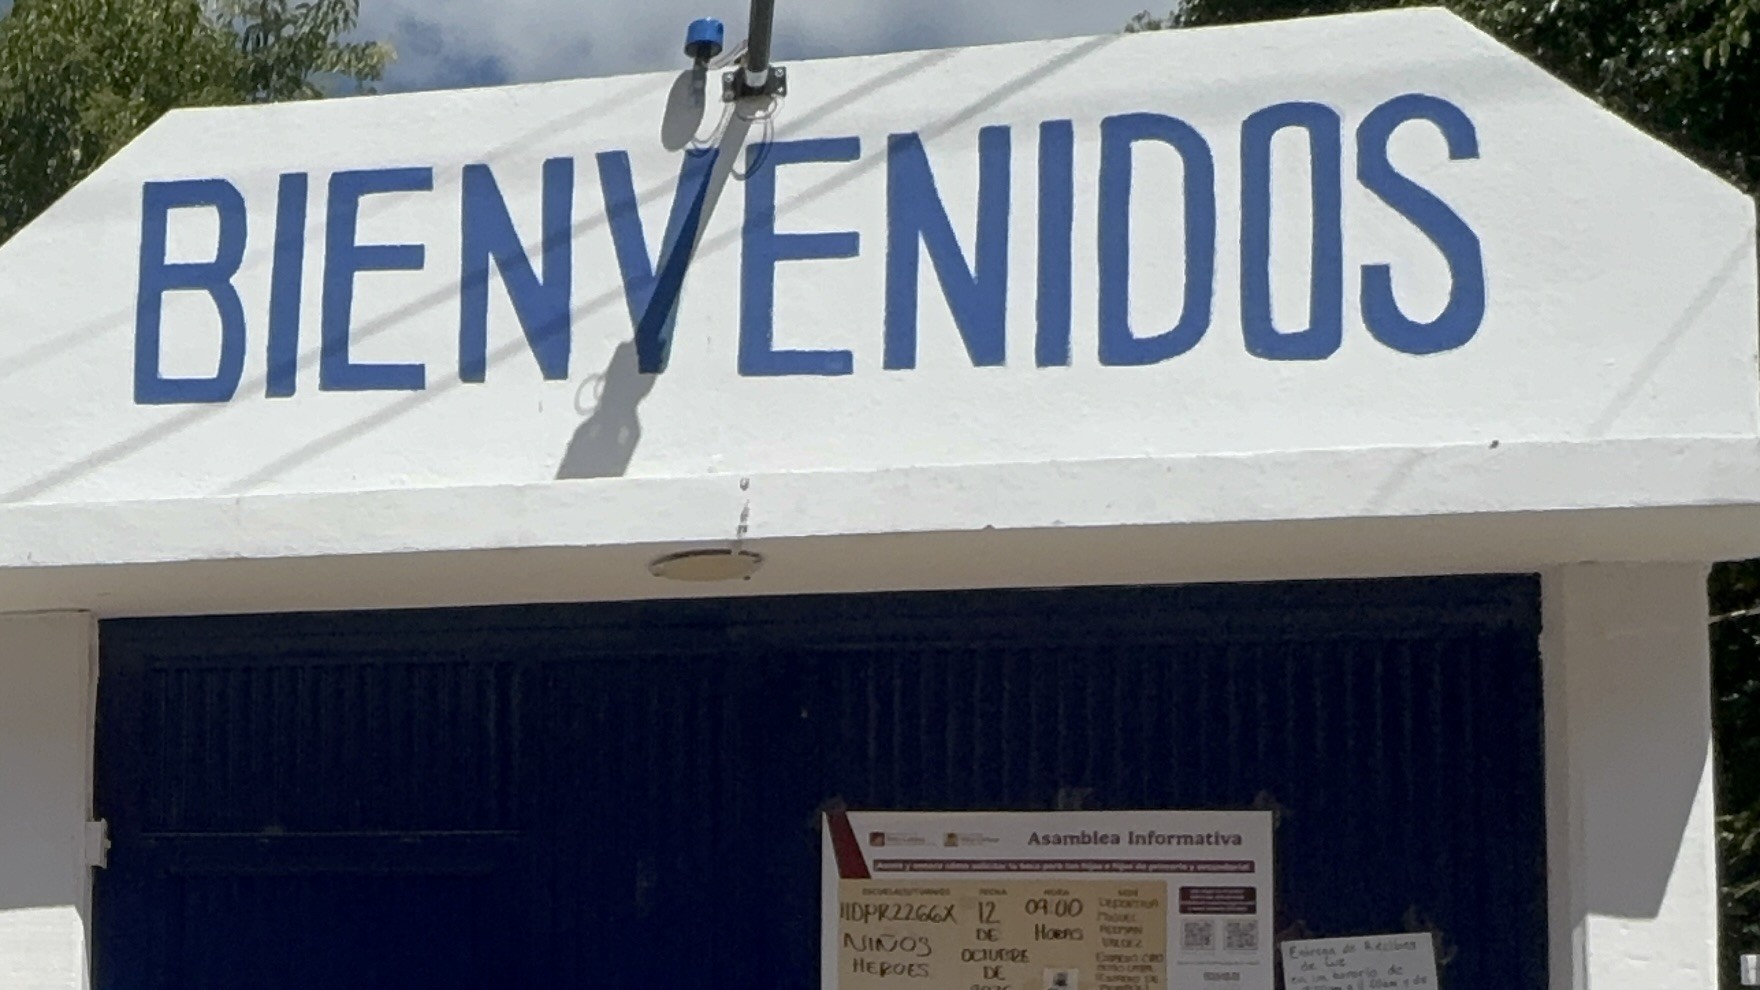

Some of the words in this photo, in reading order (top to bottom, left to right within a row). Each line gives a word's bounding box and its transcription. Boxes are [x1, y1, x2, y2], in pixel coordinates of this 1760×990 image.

[134, 93, 1486, 405] BIENVENIDOS
[1028, 830, 1120, 846] Asamblea
[1128, 830, 1243, 847] Informativa
[978, 901, 1001, 924] 12
[843, 932, 932, 958] NIÑOS
[976, 928, 999, 943] DE
[853, 957, 929, 978] HEROES
[983, 965, 1006, 981] DE
